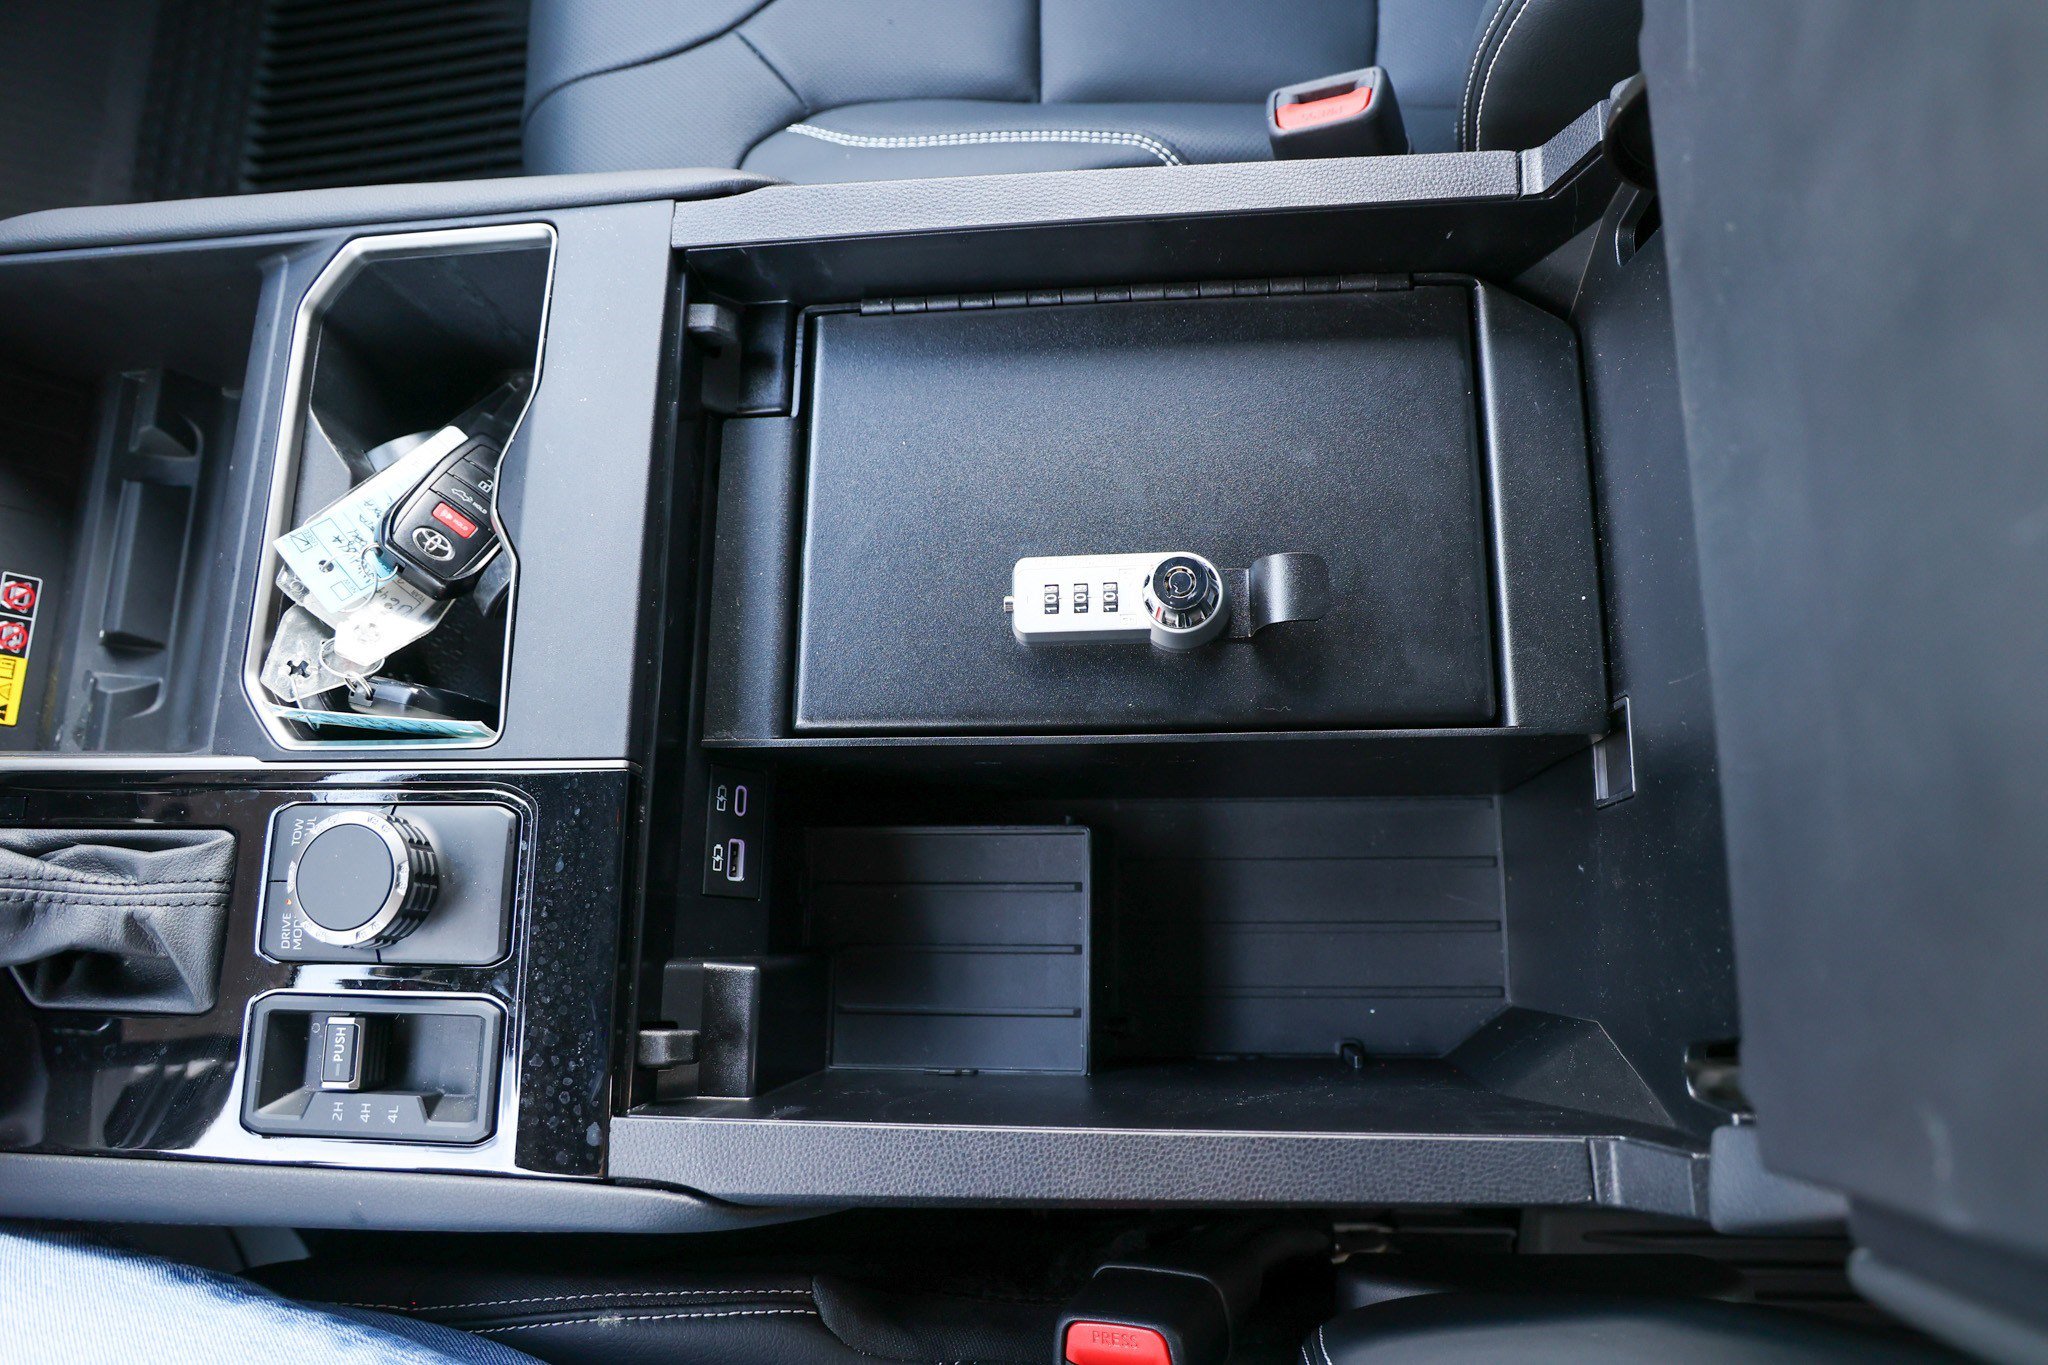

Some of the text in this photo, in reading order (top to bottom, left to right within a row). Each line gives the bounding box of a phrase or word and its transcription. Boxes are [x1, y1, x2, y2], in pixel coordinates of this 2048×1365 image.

[472, 500, 488, 515] HOLD
[291, 818, 304, 846] TOW
[281, 912, 292, 950] DRIVE
[292, 920, 303, 951] MOD
[333, 1026, 348, 1062] PUSH
[332, 1101, 345, 1122] 2H
[360, 1102, 372, 1123] 4H
[387, 1104, 400, 1124] 4L
[1091, 1330, 1139, 1349] PRESS
